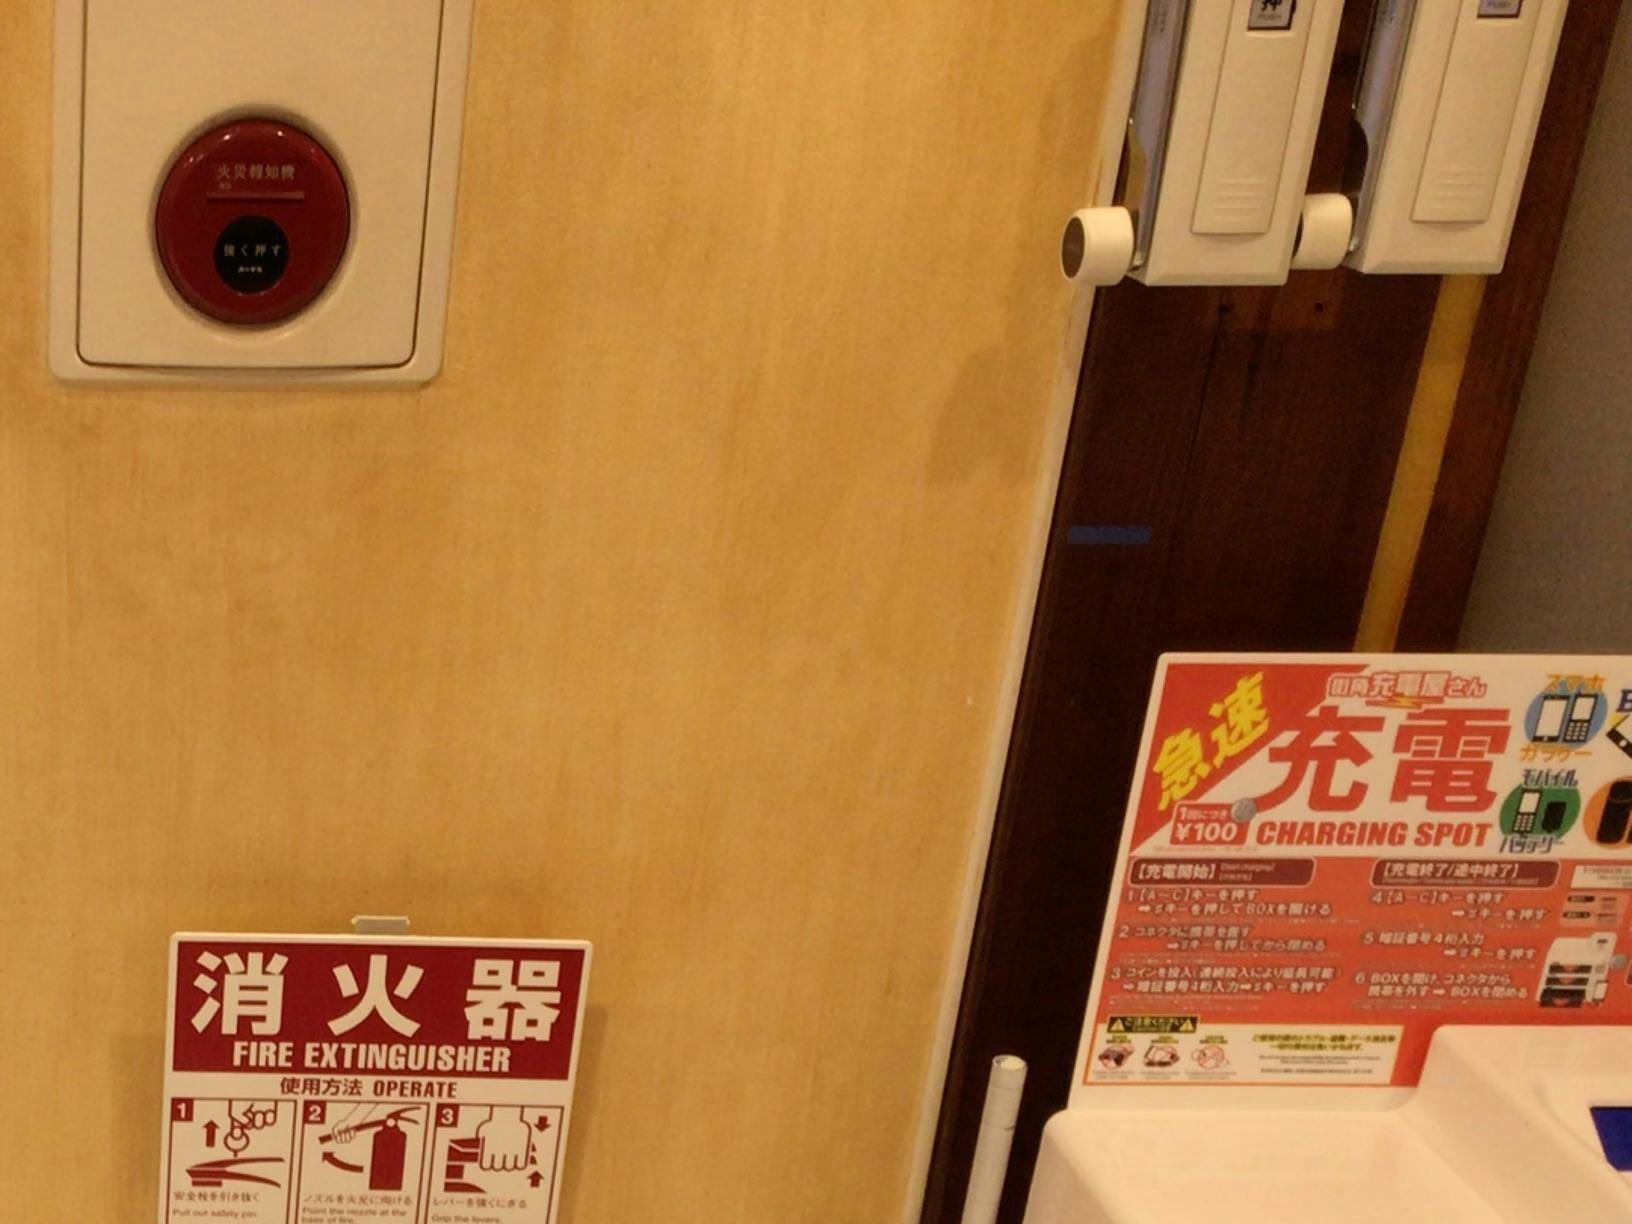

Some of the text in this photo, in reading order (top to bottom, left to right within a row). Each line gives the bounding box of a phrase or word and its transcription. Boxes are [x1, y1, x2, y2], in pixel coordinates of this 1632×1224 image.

[216, 164, 295, 180] 火災報知機
[224, 244, 282, 257] 強く押す
[1545, 674, 1608, 692] スマホ
[1153, 671, 1268, 811] 急速
[1269, 704, 1512, 813] 充電
[1522, 769, 1578, 787] モバイル
[1174, 823, 1238, 842] ¥100
[1256, 821, 1494, 848] CHARGING SPOT
[1371, 891, 1383, 904] 4
[1119, 927, 1129, 938] 2
[1363, 932, 1374, 945] 5
[1111, 967, 1121, 980] 3
[1355, 972, 1366, 985] 6
[191, 951, 561, 1041] 消火器
[233, 1041, 511, 1072] FIRE EXTINGUISHER
[280, 1077, 457, 1098] 使用方法 OPERATE
[177, 1103, 187, 1118] 1
[308, 1105, 321, 1120] 2
[441, 1108, 454, 1123] 3
